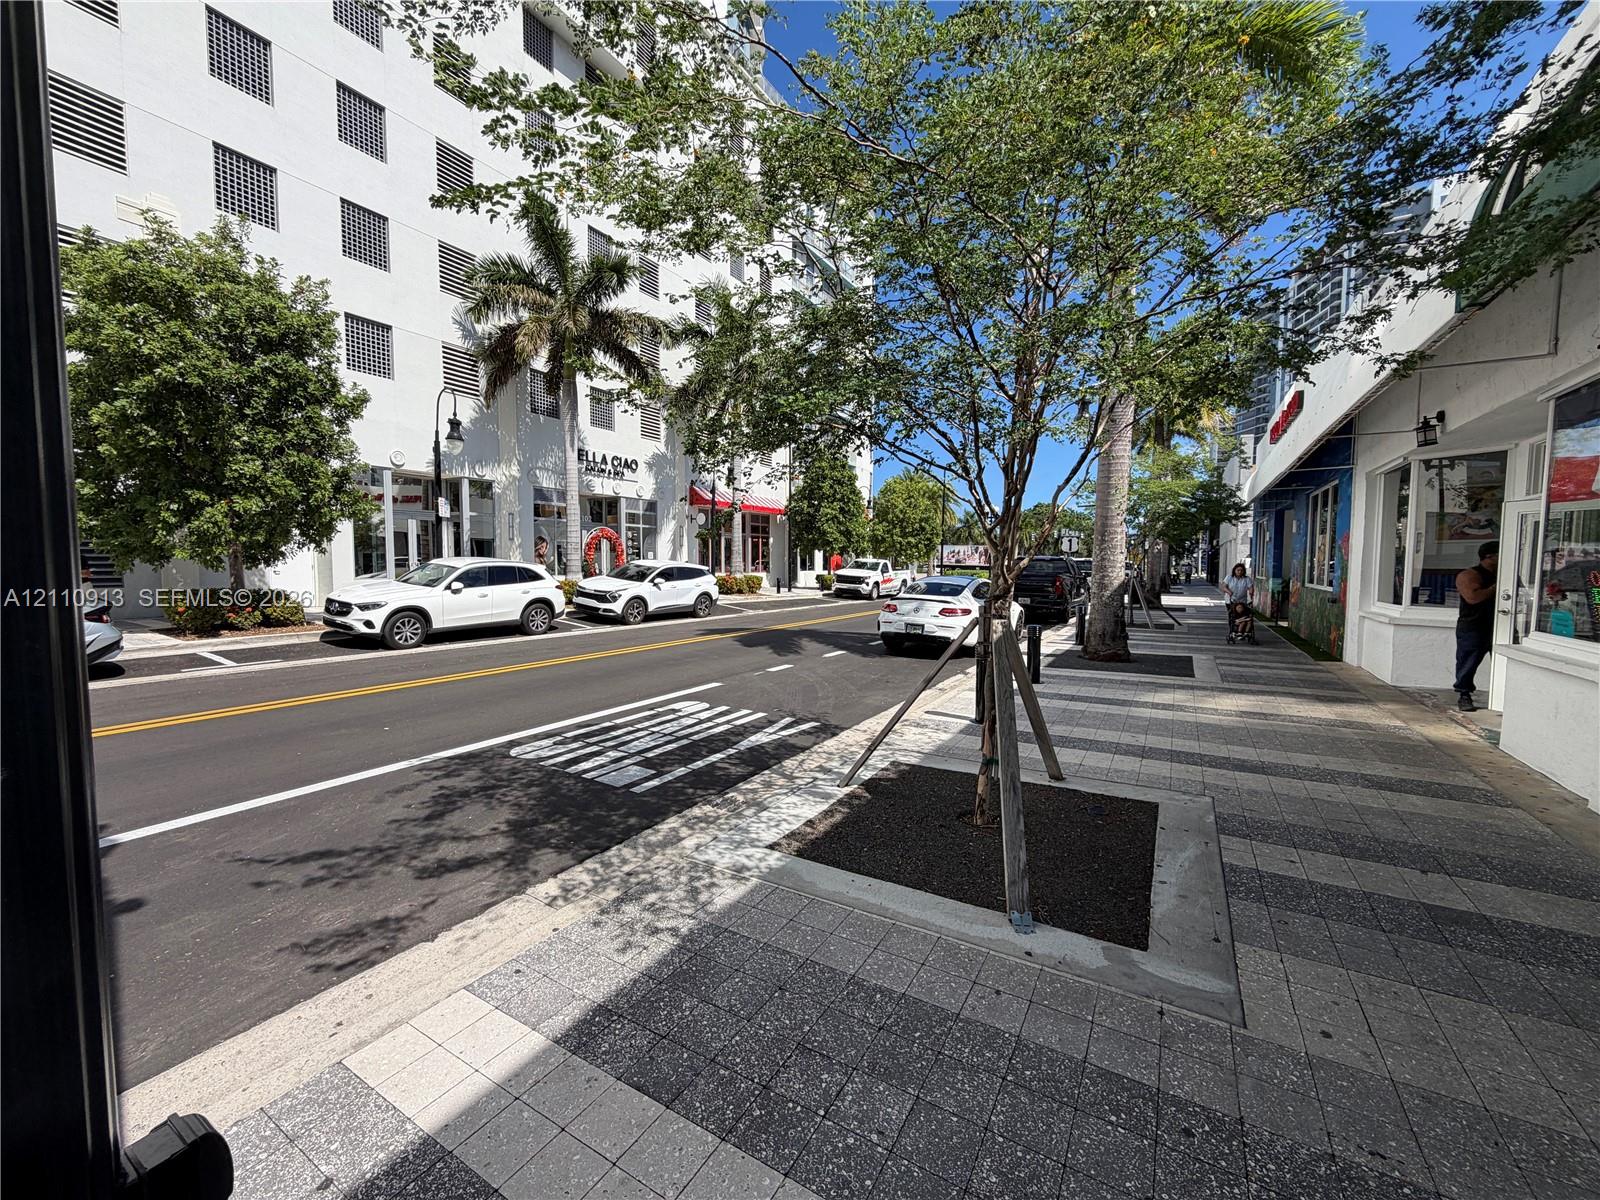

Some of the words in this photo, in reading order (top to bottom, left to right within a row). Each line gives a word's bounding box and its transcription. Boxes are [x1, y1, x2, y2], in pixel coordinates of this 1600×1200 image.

[578, 448, 608, 465] ELLA
[611, 455, 639, 472] CIAO
[509, 700, 821, 794] ONLY
